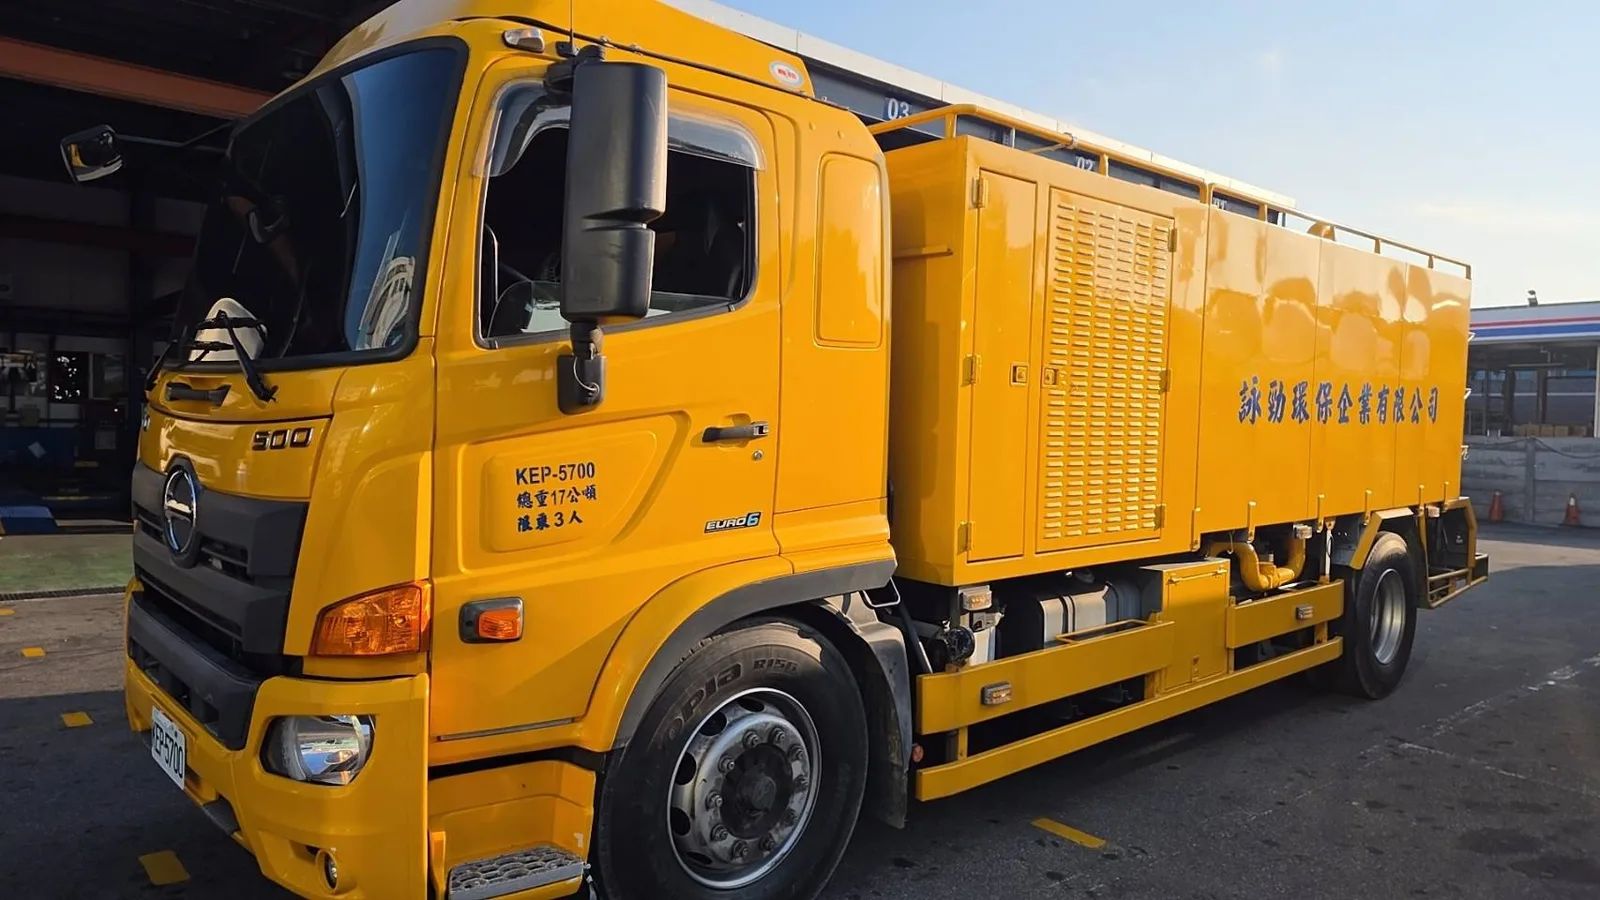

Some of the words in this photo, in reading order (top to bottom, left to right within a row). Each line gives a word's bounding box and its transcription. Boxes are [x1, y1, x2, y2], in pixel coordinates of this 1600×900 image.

[1238, 376, 1438, 425] 詠勁環保企業有限公司
[252, 427, 314, 451] 500
[515, 462, 595, 485] KEP-5700
